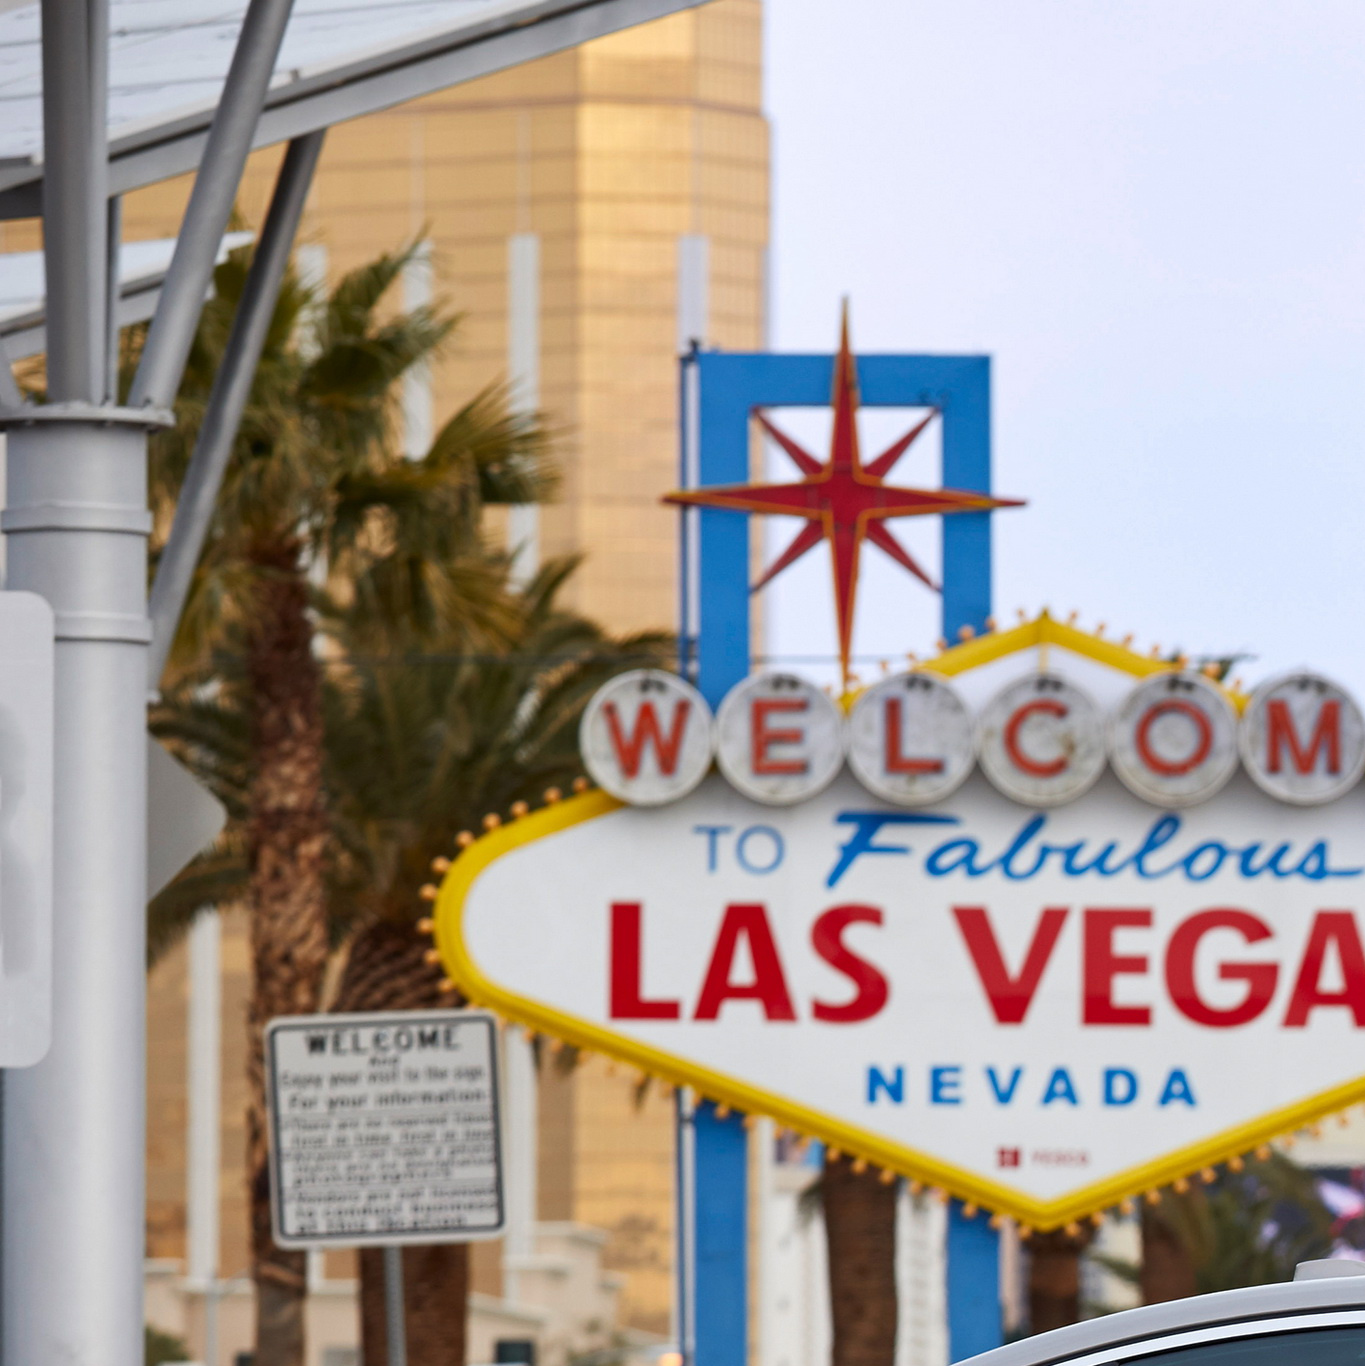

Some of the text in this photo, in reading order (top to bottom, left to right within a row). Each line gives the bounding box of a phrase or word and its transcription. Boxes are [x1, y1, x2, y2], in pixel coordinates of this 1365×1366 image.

[693, 811, 1365, 889] TO Fabulous
[608, 900, 891, 1024] LAS
[305, 1026, 462, 1055] WELCOME
[865, 1065, 1198, 1107] NEVADA
